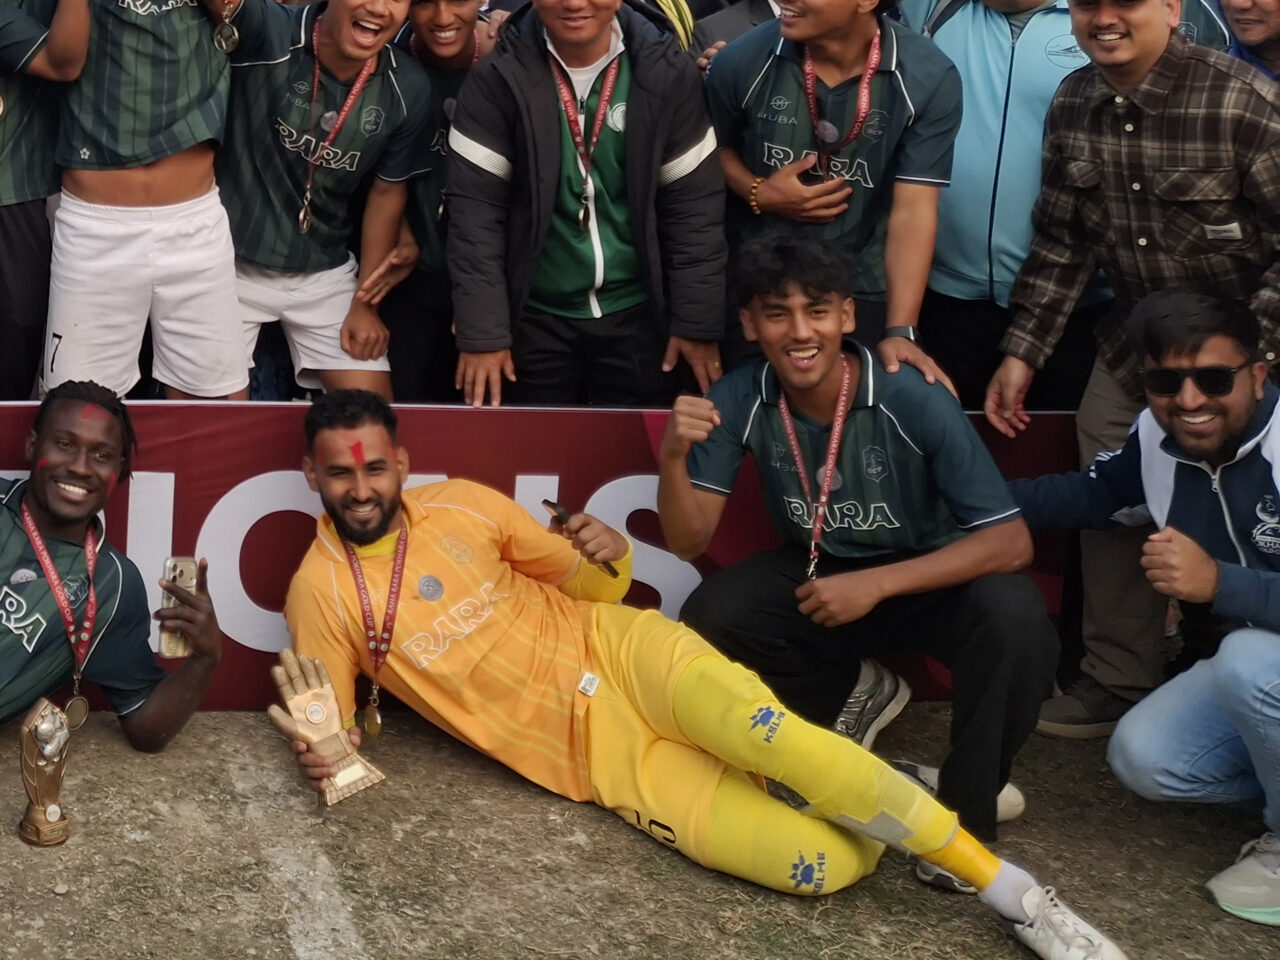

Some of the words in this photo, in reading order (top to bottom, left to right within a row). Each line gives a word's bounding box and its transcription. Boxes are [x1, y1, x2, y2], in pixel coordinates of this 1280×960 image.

[868, 47, 879, 68] AAHA
[602, 68, 615, 100] POKHARA
[857, 90, 868, 122] POKHARA
[275, 117, 361, 171] RARA
[841, 372, 849, 394] AAHA
[778, 398, 793, 433] POKHARA
[836, 395, 846, 416] RARA
[830, 416, 842, 453] POKHARA
[825, 454, 835, 476] GOLD
[822, 477, 830, 492] CUP
[783, 496, 900, 532] RARA
[22, 511, 36, 532] AAHA
[30, 530, 44, 551] RARA
[39, 549, 59, 586] POKHARA
[54, 584, 69, 608] GOLD
[63, 607, 74, 623] CUP
[349, 554, 365, 588] POKHARA
[394, 539, 405, 573] POKHARA
[390, 572, 400, 592] RARA
[359, 588, 371, 611] GOLD
[386, 592, 397, 615] AAHA
[364, 611, 375, 628] CUP
[401, 582, 510, 670] RARA
[763, 711, 786, 743] KELME
